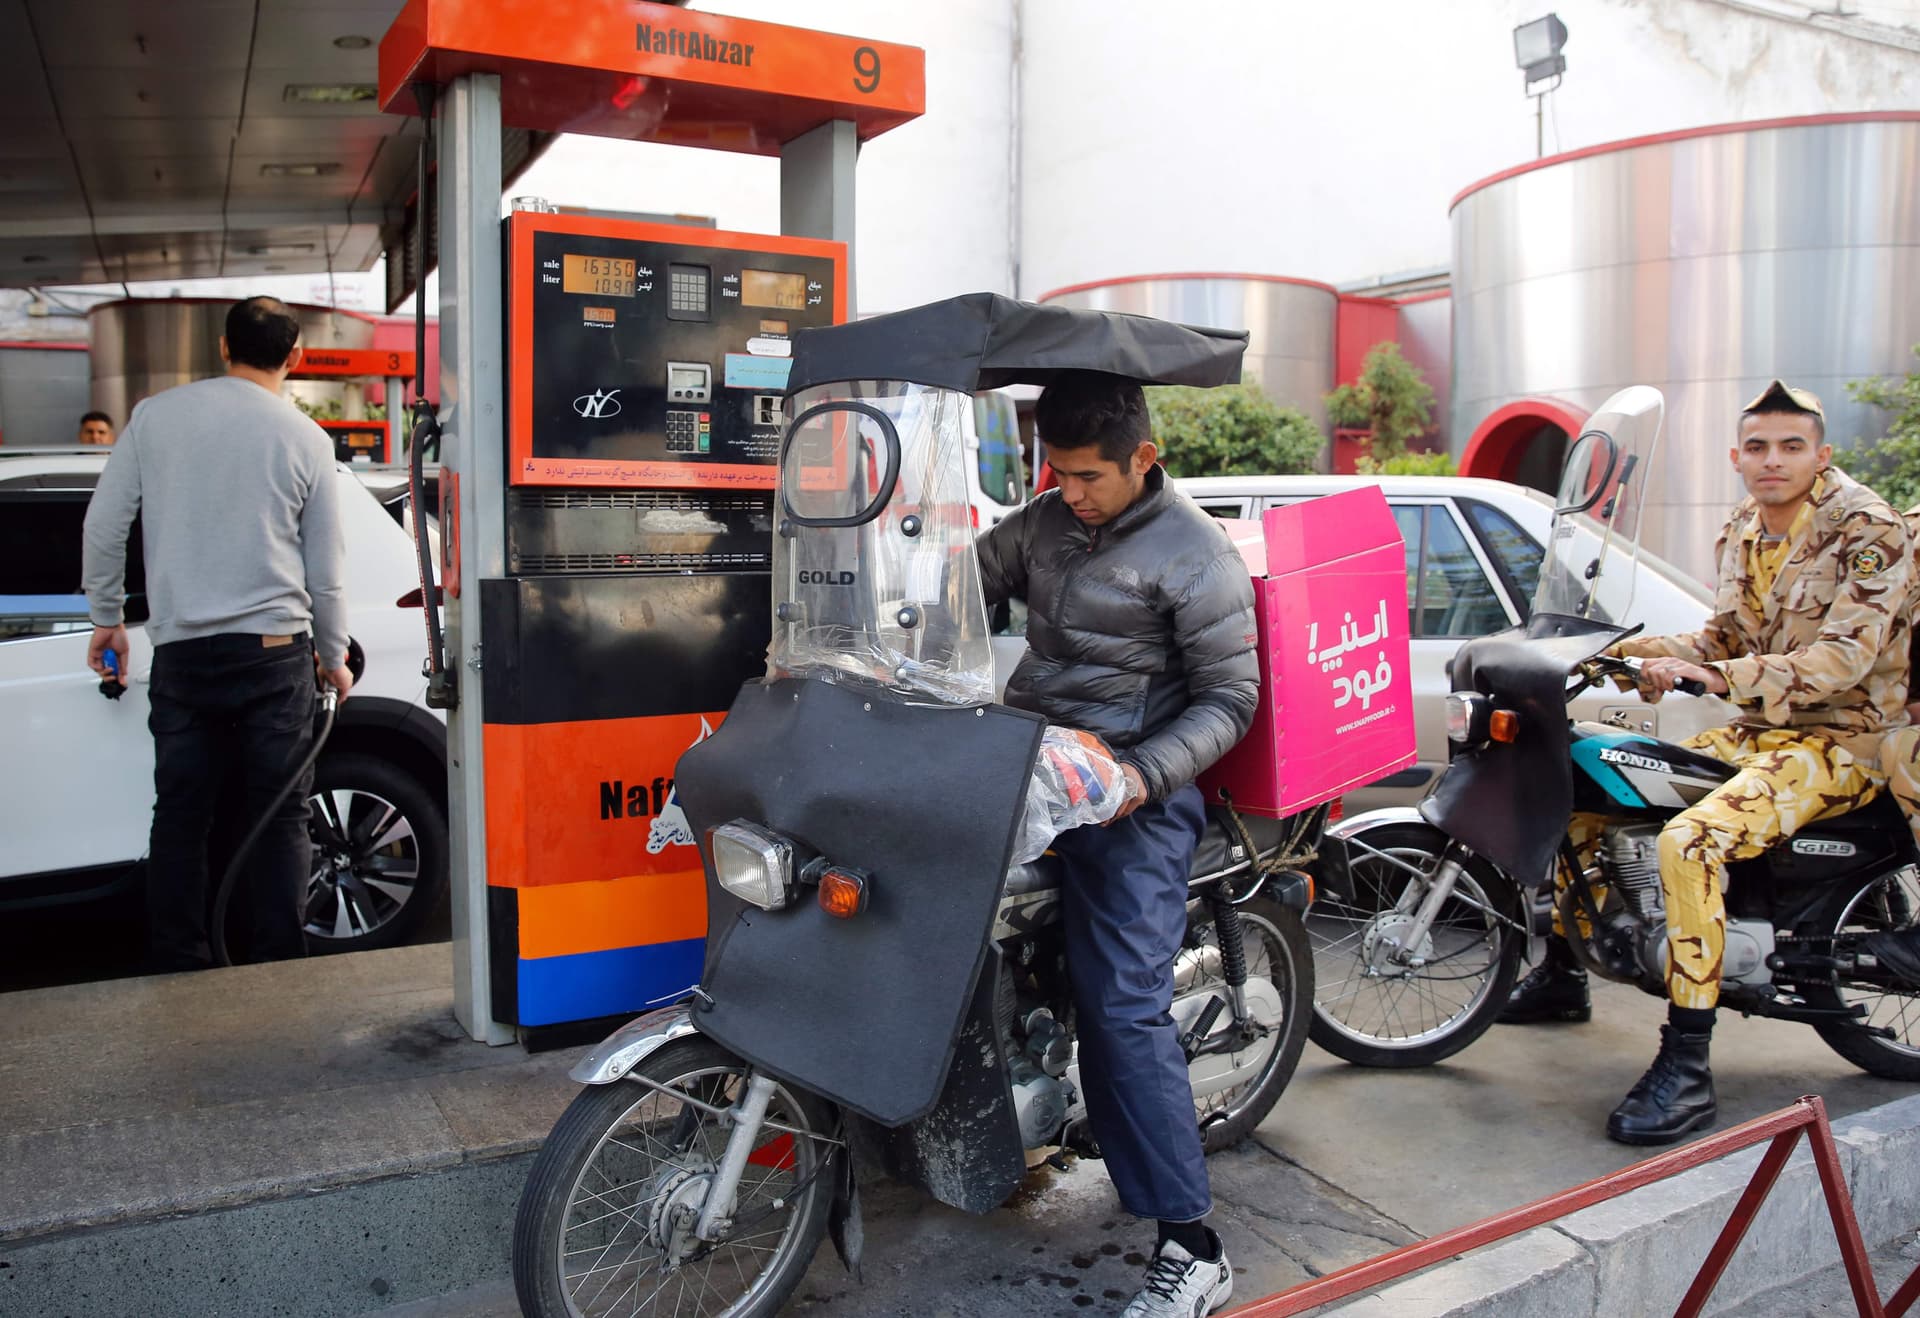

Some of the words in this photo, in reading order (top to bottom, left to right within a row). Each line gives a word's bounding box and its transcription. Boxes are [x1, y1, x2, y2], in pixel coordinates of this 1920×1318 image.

[636, 23, 754, 67] NaftAbzar
[853, 46, 881, 94] 9
[544, 260, 560, 269] sale
[584, 259, 634, 278] 16350
[637, 266, 653, 277] مبلغ
[542, 274, 561, 284] liter
[723, 274, 738, 283] sale
[807, 280, 822, 291] مبلغ
[722, 288, 739, 297] liter
[387, 352, 400, 370] 3
[799, 570, 856, 586] GOLD
[1332, 651, 1392, 710] فود
[1600, 748, 1674, 774] HONDA
